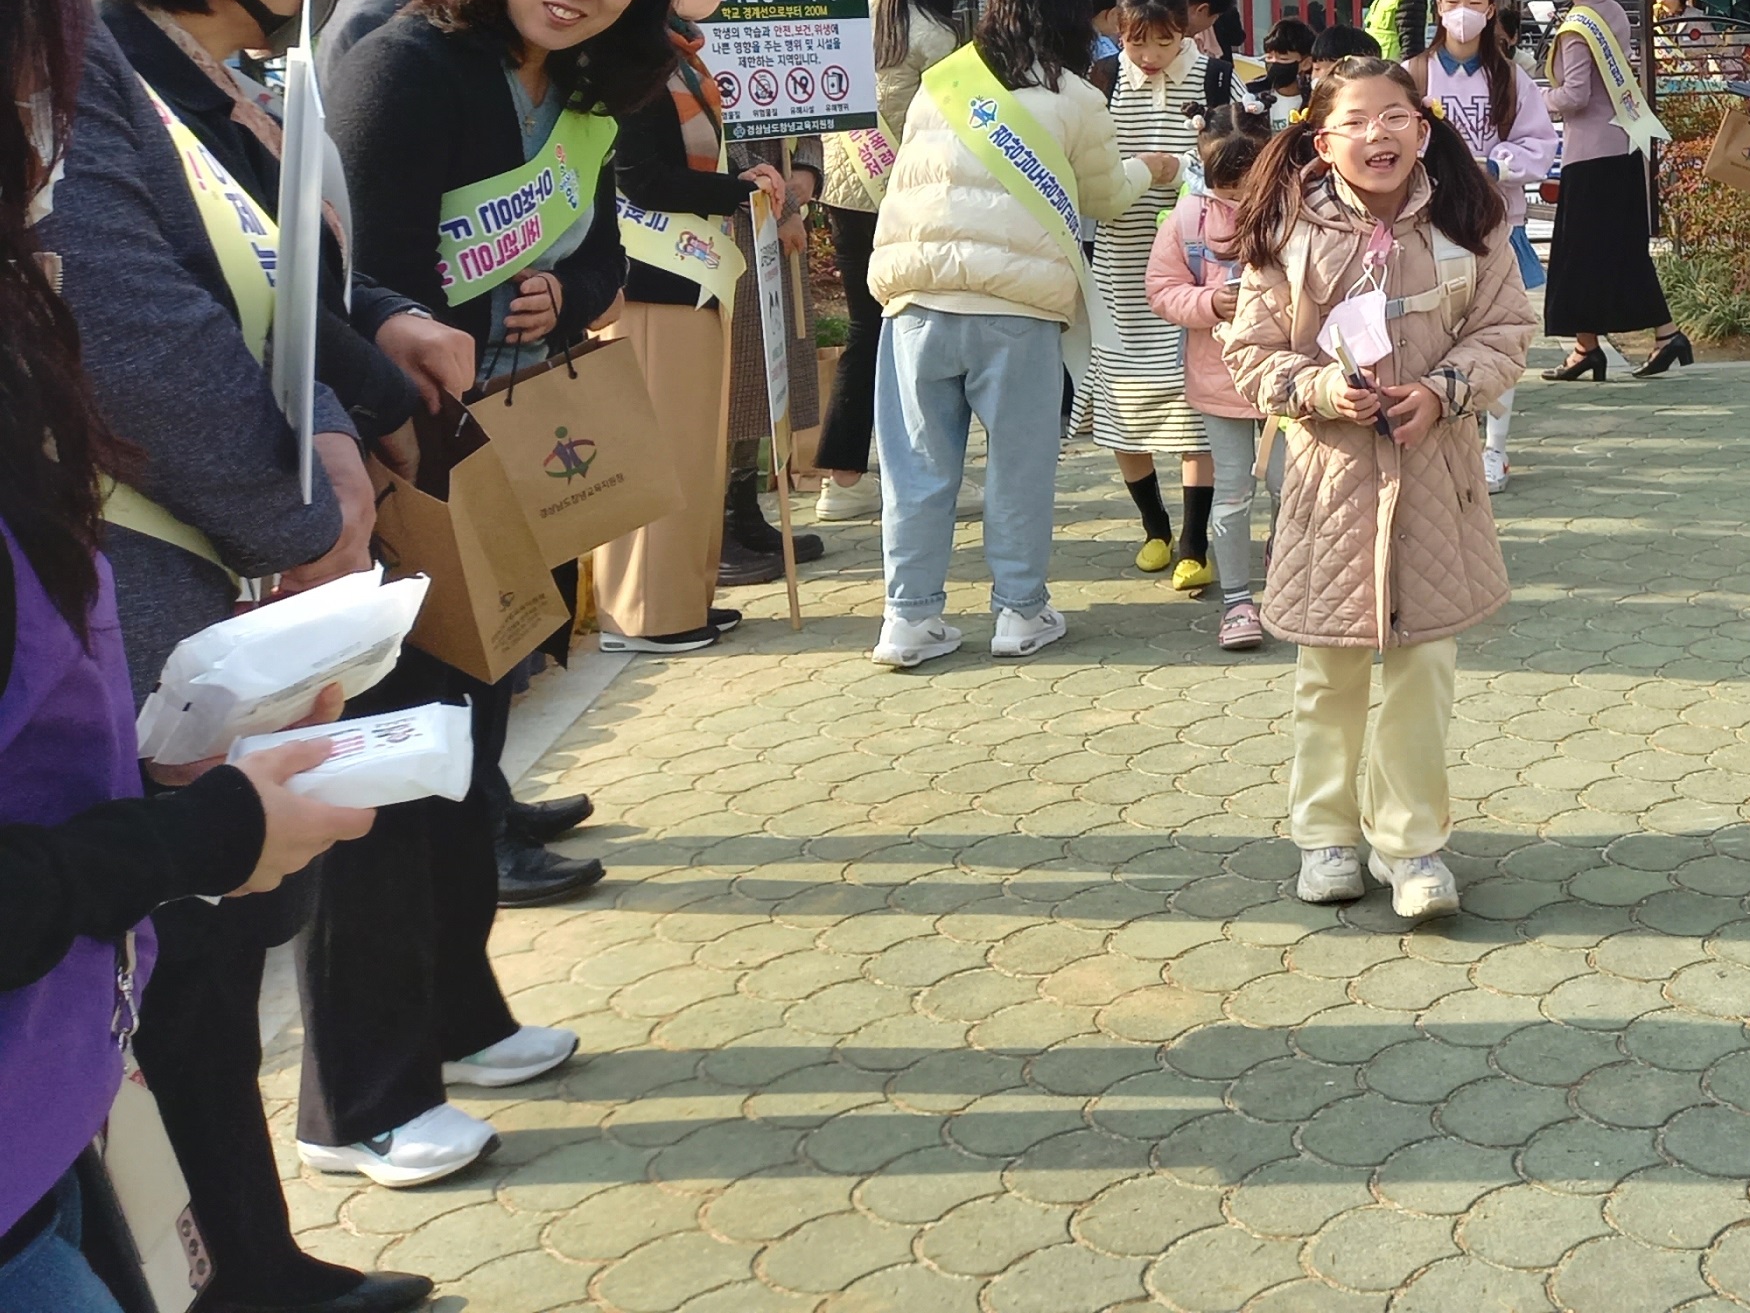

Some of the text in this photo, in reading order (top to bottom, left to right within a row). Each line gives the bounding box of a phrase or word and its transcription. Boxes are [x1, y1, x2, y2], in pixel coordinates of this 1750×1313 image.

[721, 6, 741, 19] 학교
[743, 5, 803, 20] 경계선으로부터
[713, 27, 740, 39] 학생의
[744, 25, 771, 38] 학습과
[712, 37, 841, 54] 나쁜 영향을 주는 행위 및 시설을
[738, 55, 774, 68] 제한하는
